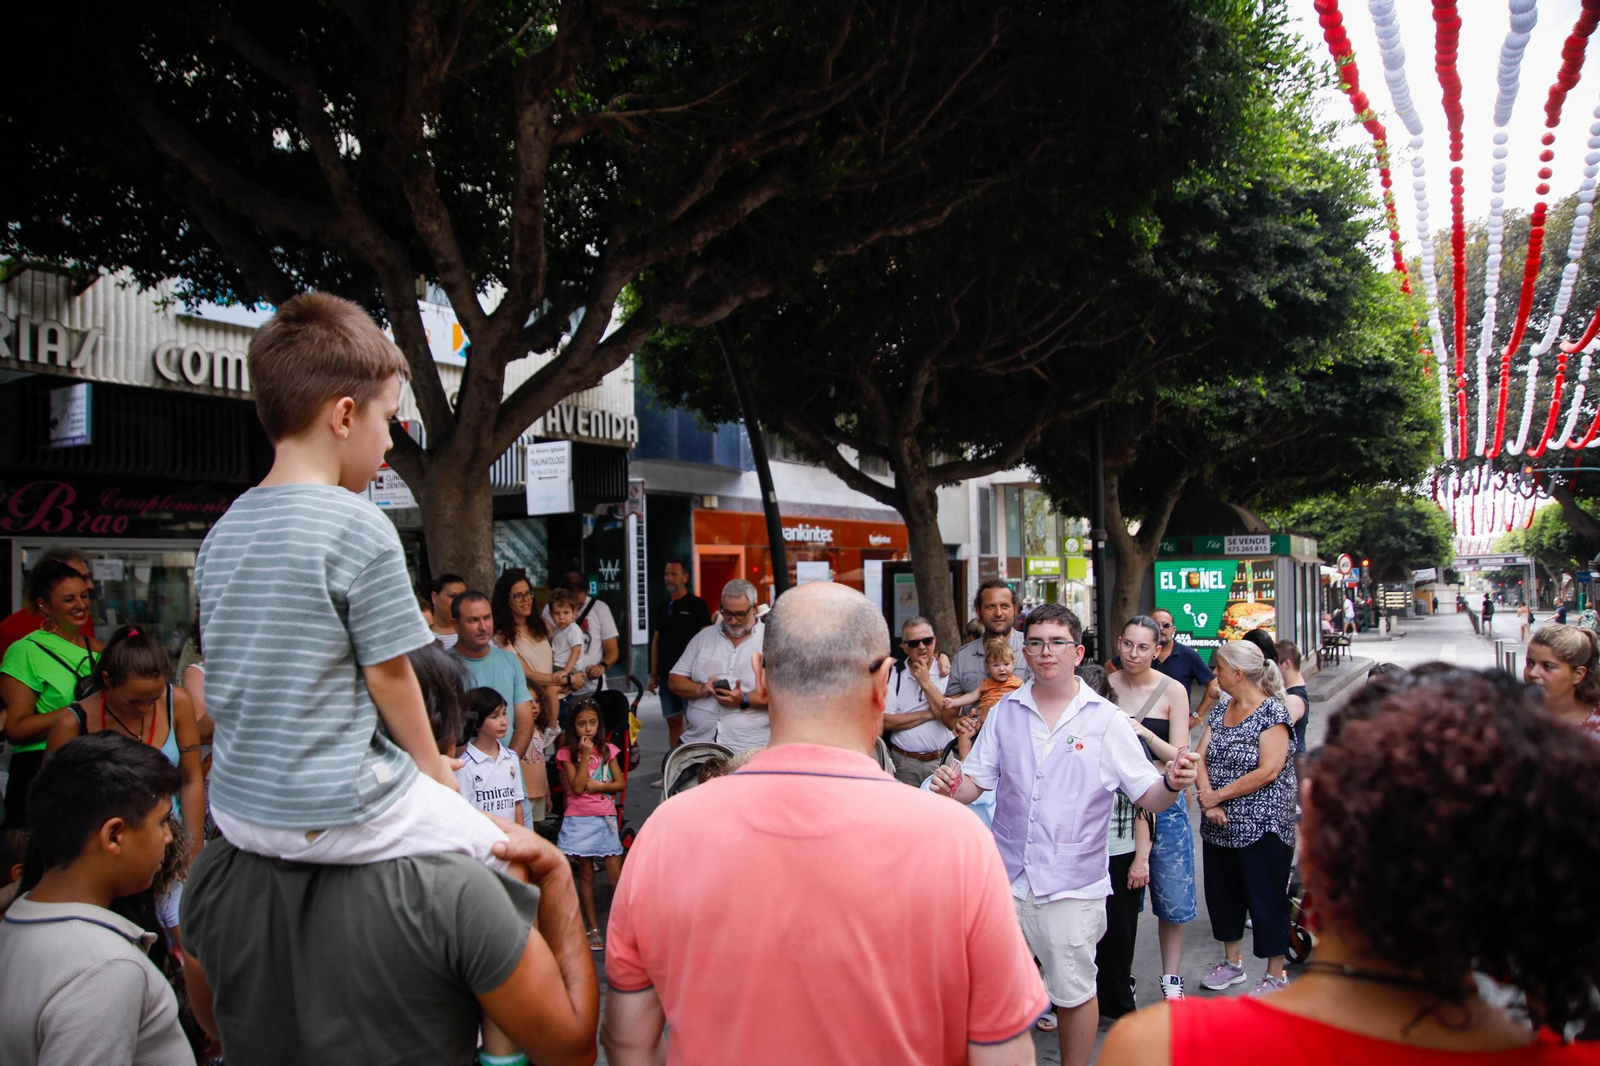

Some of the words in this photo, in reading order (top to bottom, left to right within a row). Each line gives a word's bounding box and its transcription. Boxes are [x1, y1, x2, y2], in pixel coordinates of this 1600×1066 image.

[546, 403, 639, 443] AVENIDA
[1239, 537, 1267, 545] VENDE
[1160, 571, 1177, 589] EL
